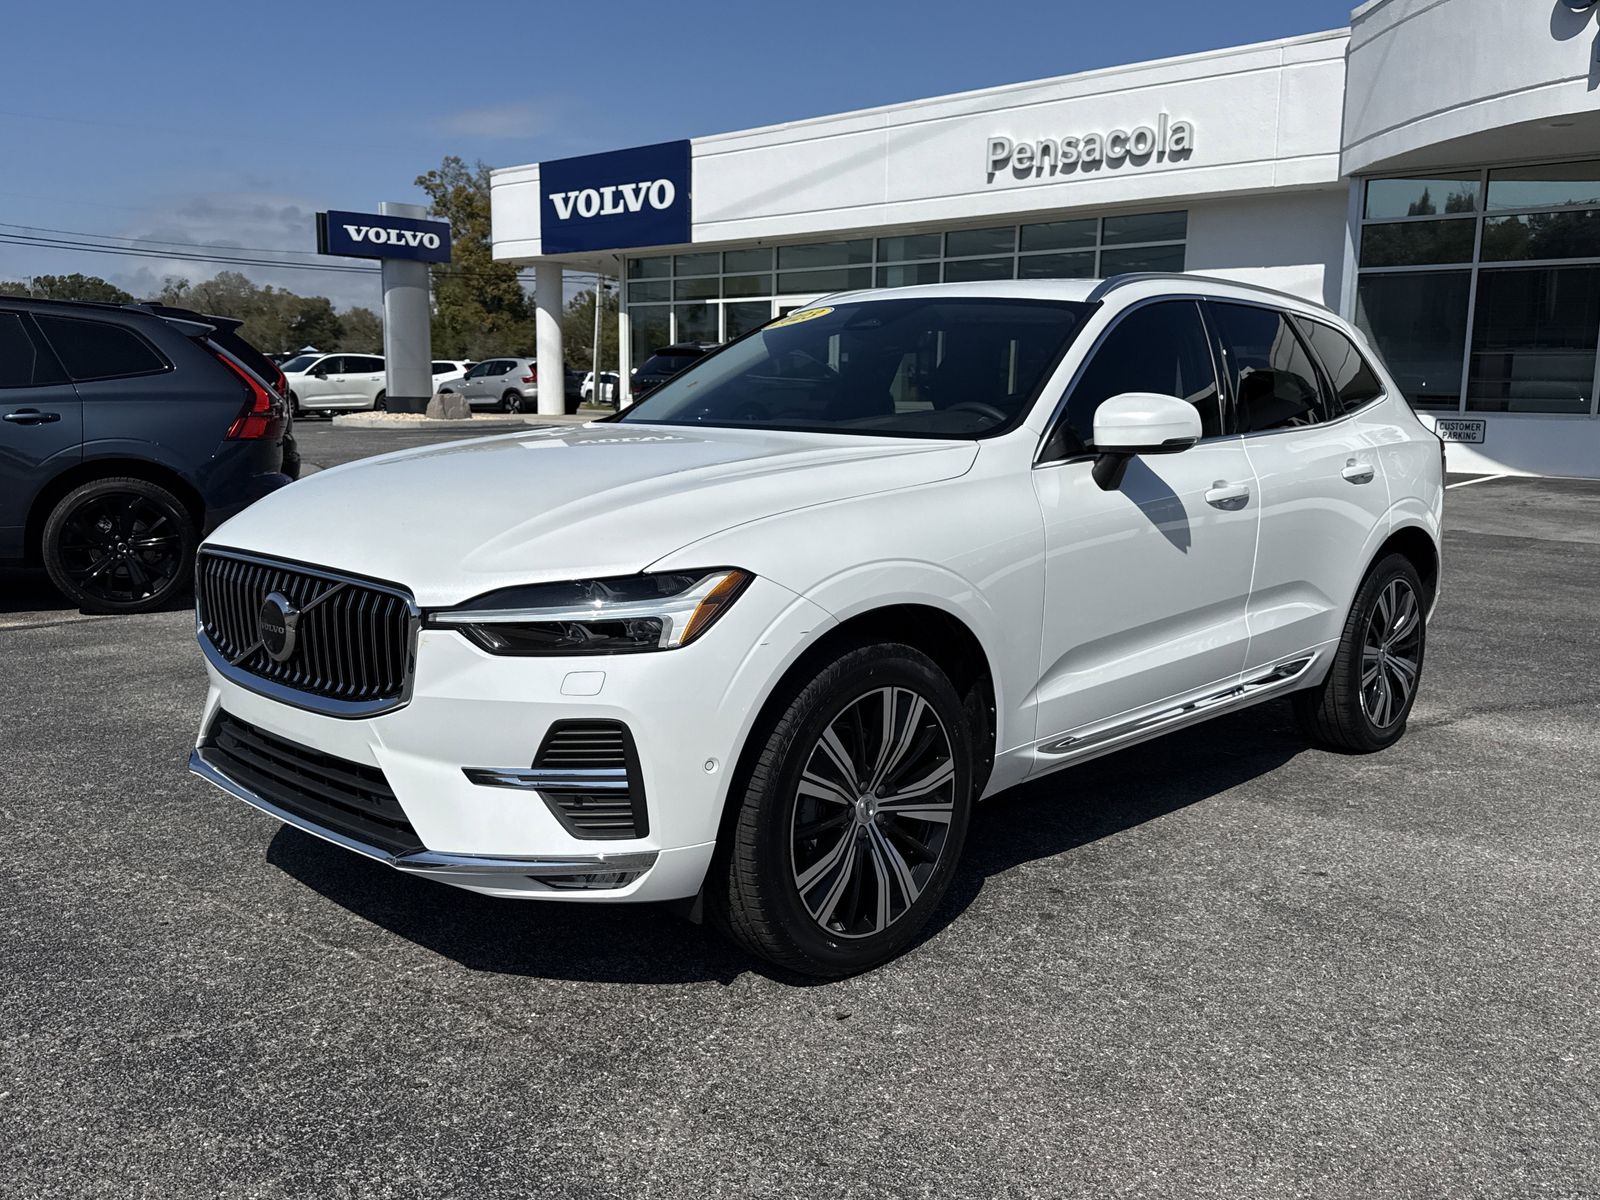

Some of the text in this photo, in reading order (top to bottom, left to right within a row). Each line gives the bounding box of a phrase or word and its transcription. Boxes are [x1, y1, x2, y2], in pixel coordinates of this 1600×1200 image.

[986, 113, 1193, 174] Pensacola
[549, 178, 676, 220] VOLVO
[342, 224, 440, 249] VOLVO
[1440, 422, 1481, 431] CUSTOMER
[1442, 431, 1477, 440] PARKING
